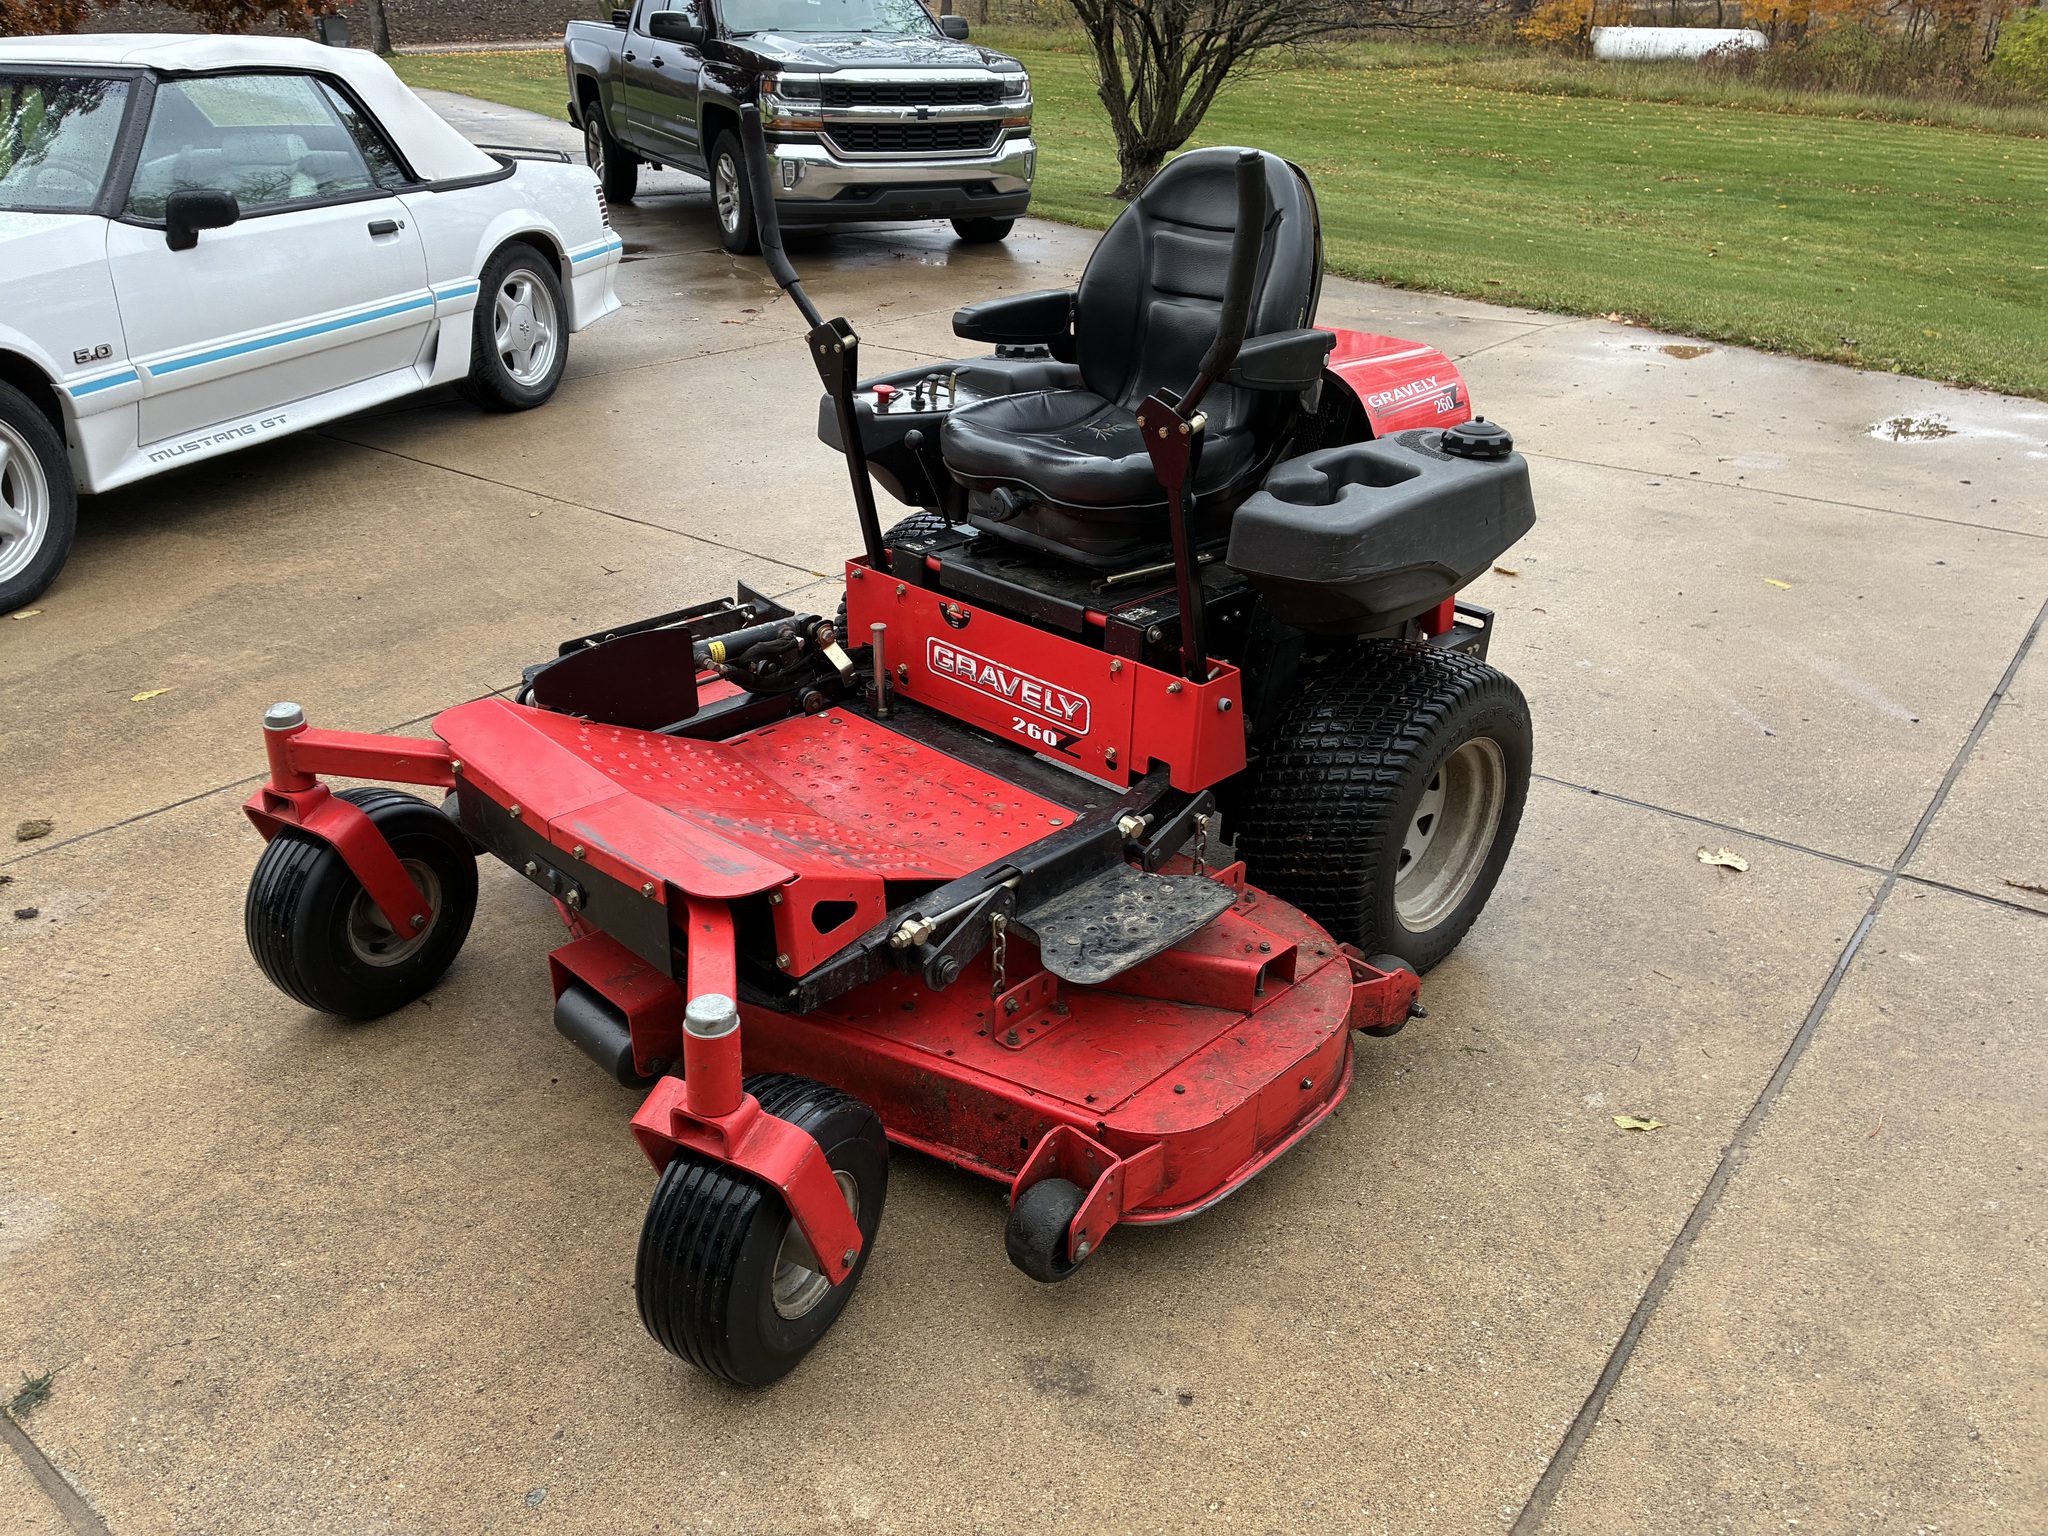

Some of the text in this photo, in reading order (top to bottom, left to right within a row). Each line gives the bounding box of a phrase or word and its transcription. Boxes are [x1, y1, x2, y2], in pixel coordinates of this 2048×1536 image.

[73, 343, 113, 364] 5.0
[1367, 376, 1438, 408] GRAVELY
[148, 414, 286, 463] MUSTANG GT
[933, 645, 1083, 721] GRAVELY
